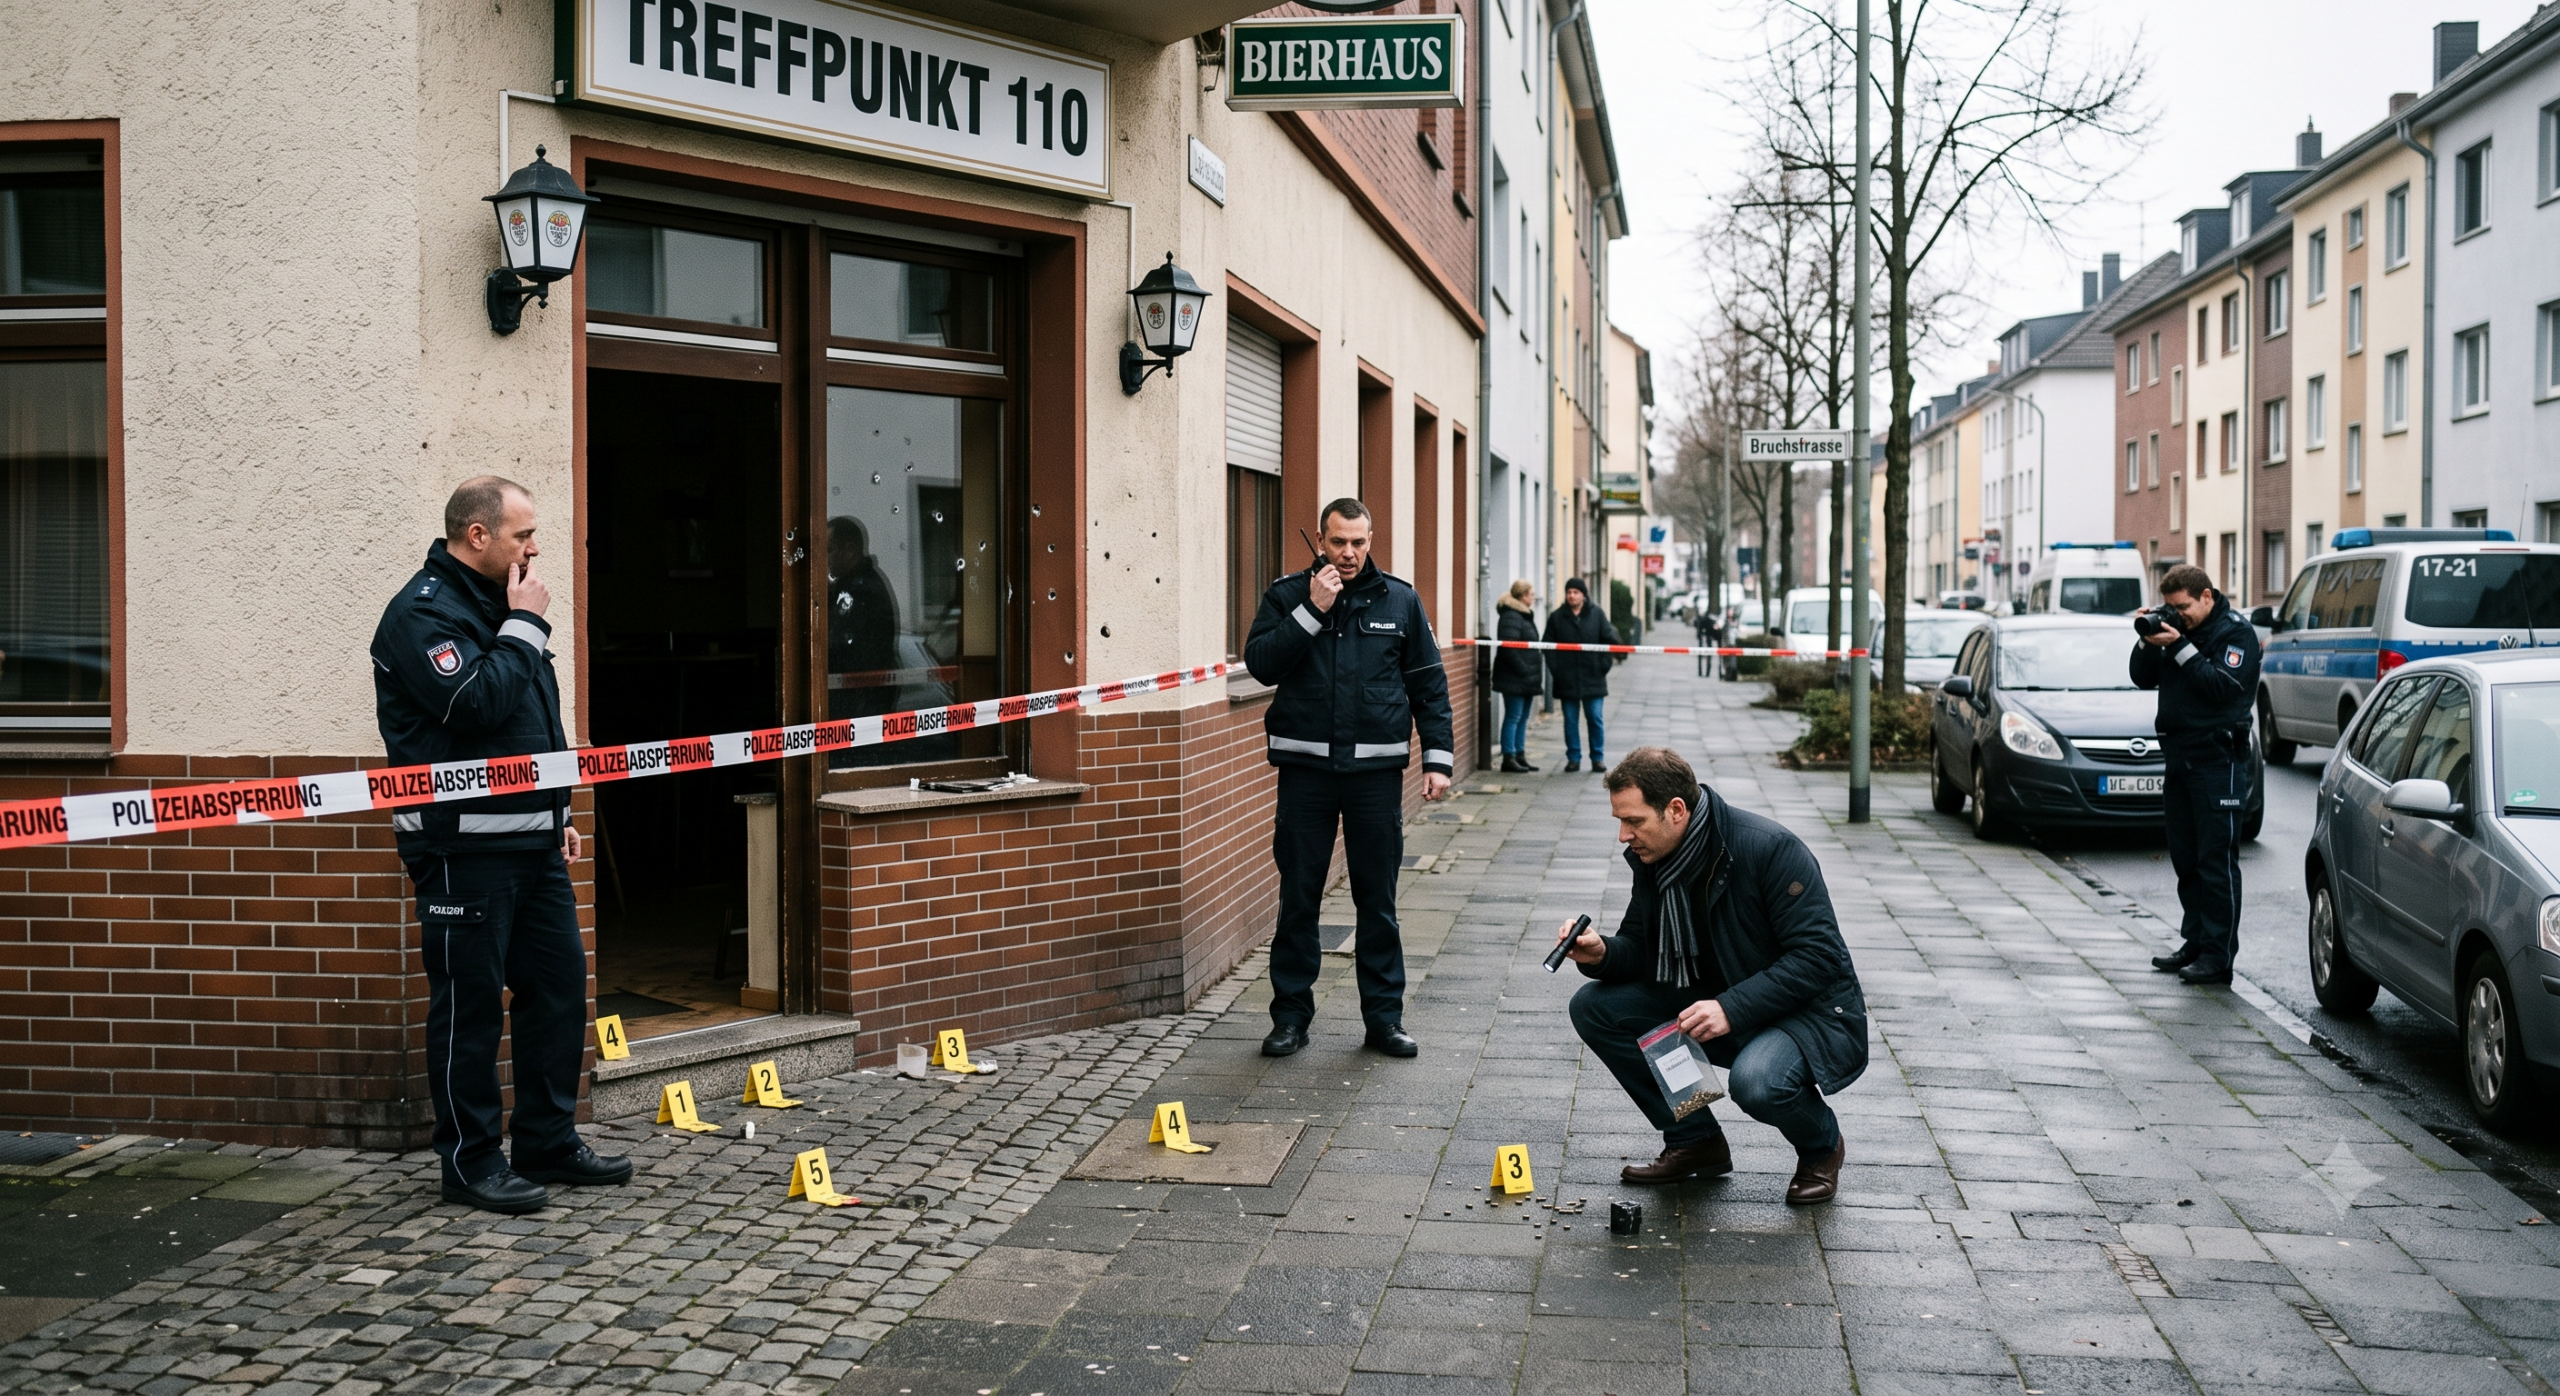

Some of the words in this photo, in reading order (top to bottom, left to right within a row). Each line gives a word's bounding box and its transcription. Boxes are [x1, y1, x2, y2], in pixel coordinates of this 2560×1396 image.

[1240, 36, 1442, 83] BIERHAUS
[629, 0, 989, 136] TREFFPUNKT
[1007, 75, 1088, 157] 110
[2419, 558, 2477, 577] 17-21
[112, 783, 322, 827] POLIZEIABSPERRUNG
[368, 761, 540, 800] POLIZEIABSPERRUNG
[577, 741, 715, 777] POLIZEIABSPERRUNG
[744, 723, 856, 756] POLIZEIABSPERRUNG
[882, 707, 977, 737] POLIZEIABSPERRUNG
[606, 1023, 619, 1047] 4
[947, 1036, 960, 1058] 3
[760, 1069, 774, 1092] 2
[675, 1089, 687, 1113] 1
[1168, 1110, 1181, 1134] 4
[809, 1158, 824, 1186] 5
[1508, 1153, 1523, 1179] 3
